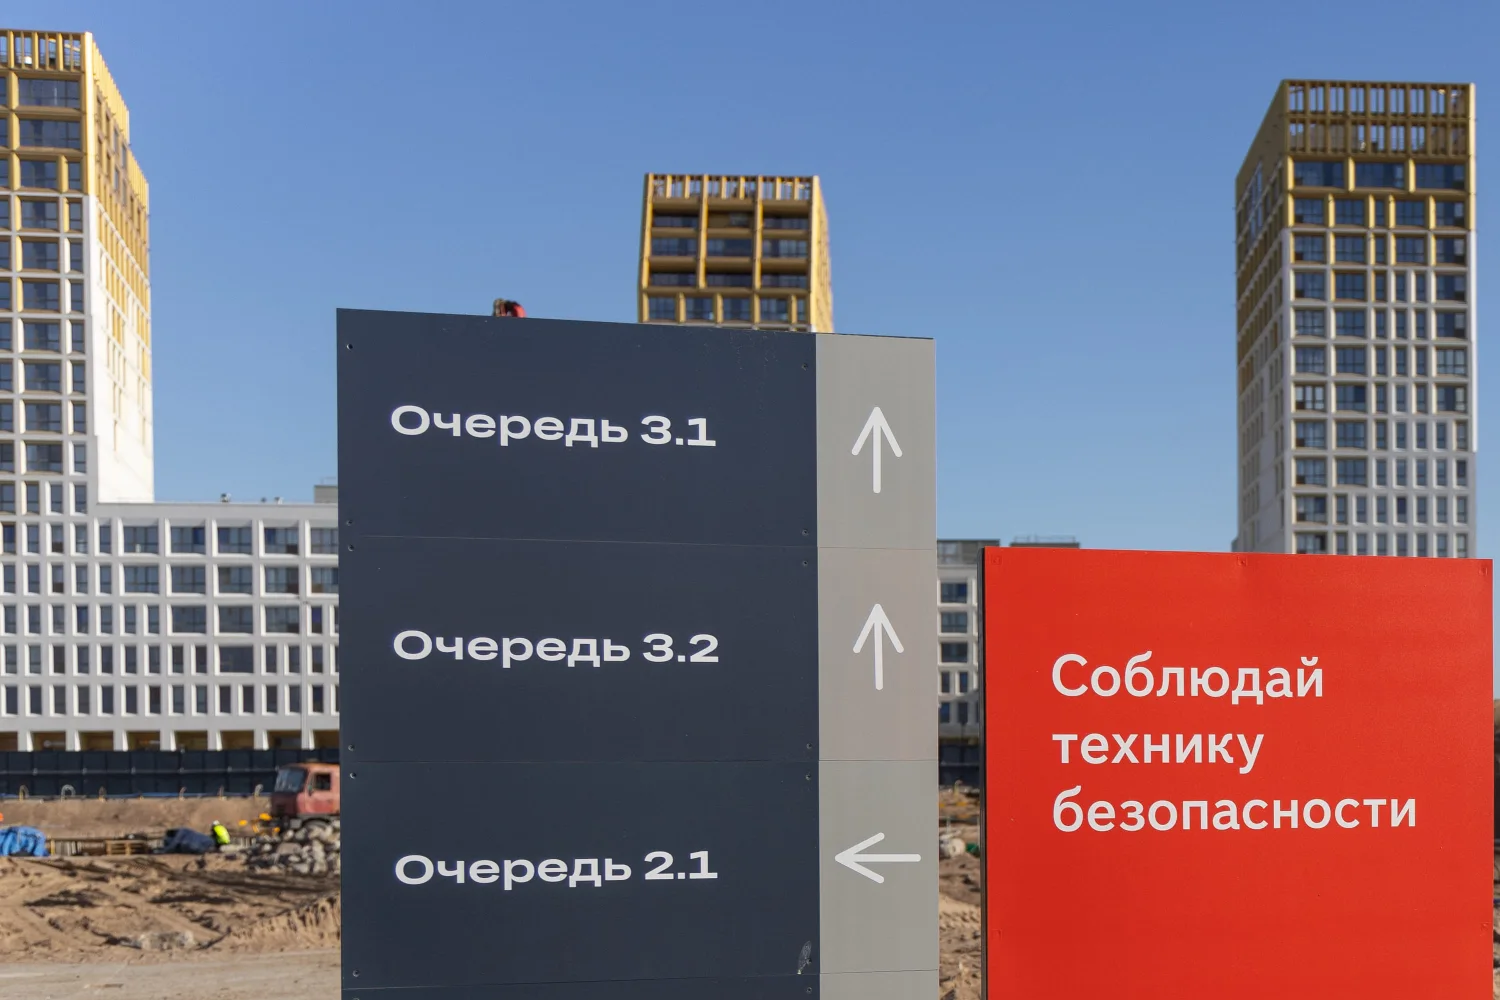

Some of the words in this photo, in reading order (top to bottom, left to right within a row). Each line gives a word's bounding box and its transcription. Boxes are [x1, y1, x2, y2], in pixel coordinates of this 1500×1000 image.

[390, 405, 629, 448] Очередь
[640, 415, 717, 447] 3.1
[393, 630, 631, 669] Очередь
[642, 633, 719, 663] 3.2
[1052, 650, 1323, 705] Соблюдай
[1052, 733, 1265, 775] технику
[1053, 785, 1416, 833] безопасности
[395, 854, 632, 891] Очередь
[644, 850, 718, 880] 2.1
